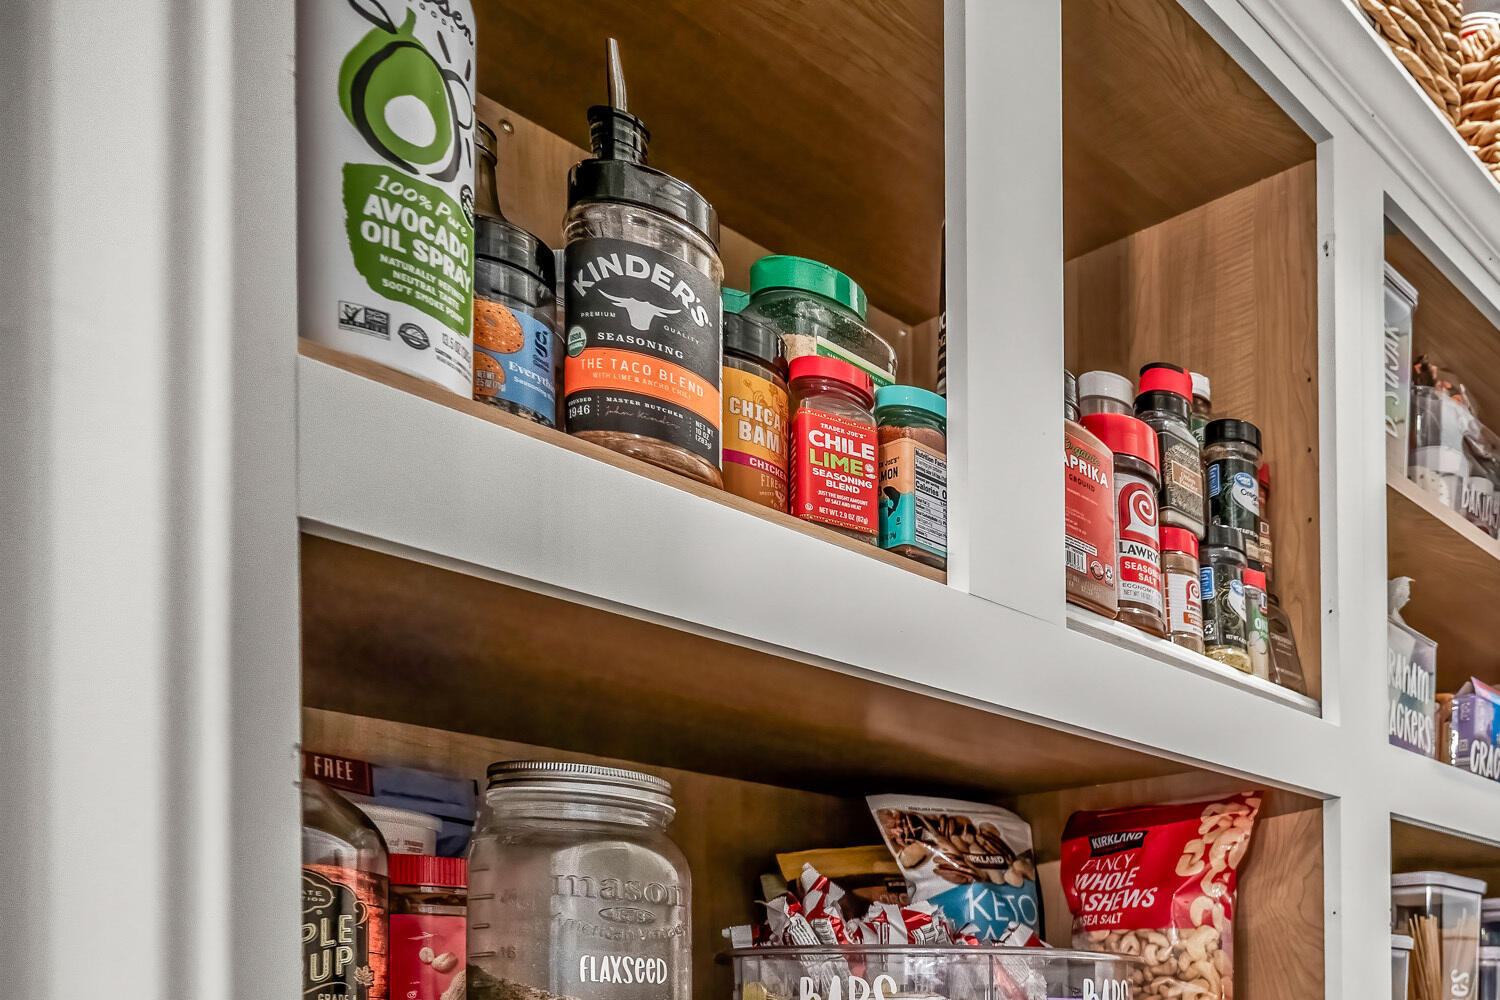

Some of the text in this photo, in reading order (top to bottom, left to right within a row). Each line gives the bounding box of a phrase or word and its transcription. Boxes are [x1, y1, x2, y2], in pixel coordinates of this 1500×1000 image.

[408, 0, 455, 33] OODS
[374, 174, 468, 238] 100% Pure
[363, 193, 470, 267] AVOCADO
[360, 220, 471, 293] OIL SPRAY
[379, 254, 437, 283] NATURALLY
[392, 270, 437, 297] NEUTRAL
[572, 253, 709, 328] KINDER'S
[597, 331, 684, 359] SEASONING
[663, 324, 700, 345] QUALITY
[508, 360, 555, 392] Everyth
[580, 358, 704, 397] THE TACO BLEND
[613, 372, 633, 382] LIME
[569, 404, 591, 419] 1946
[606, 396, 684, 419] MASTER BUTCHER
[695, 420, 706, 431] NET
[820, 422, 867, 439] TRADER JOE'S
[808, 429, 875, 461] CHILE
[809, 447, 864, 477] LIME
[1064, 449, 1109, 489] APRIKA
[812, 467, 873, 489] SEASONING
[825, 479, 860, 494] BLEND
[916, 480, 939, 497] Calories
[1068, 473, 1096, 492] GROUND
[819, 506, 829, 515] NET
[1119, 541, 1159, 564] LAWRY
[1124, 561, 1160, 581] SEASON
[1138, 572, 1157, 587] SALT
[313, 756, 354, 781] FREE
[1091, 831, 1144, 849] KIRKLAND
[1075, 866, 1140, 891] WHOLE
[965, 887, 1038, 926] KETO
[1081, 886, 1158, 912] SHEWS
[303, 915, 354, 948] PLE
[1082, 912, 1123, 926] SEA SALT
